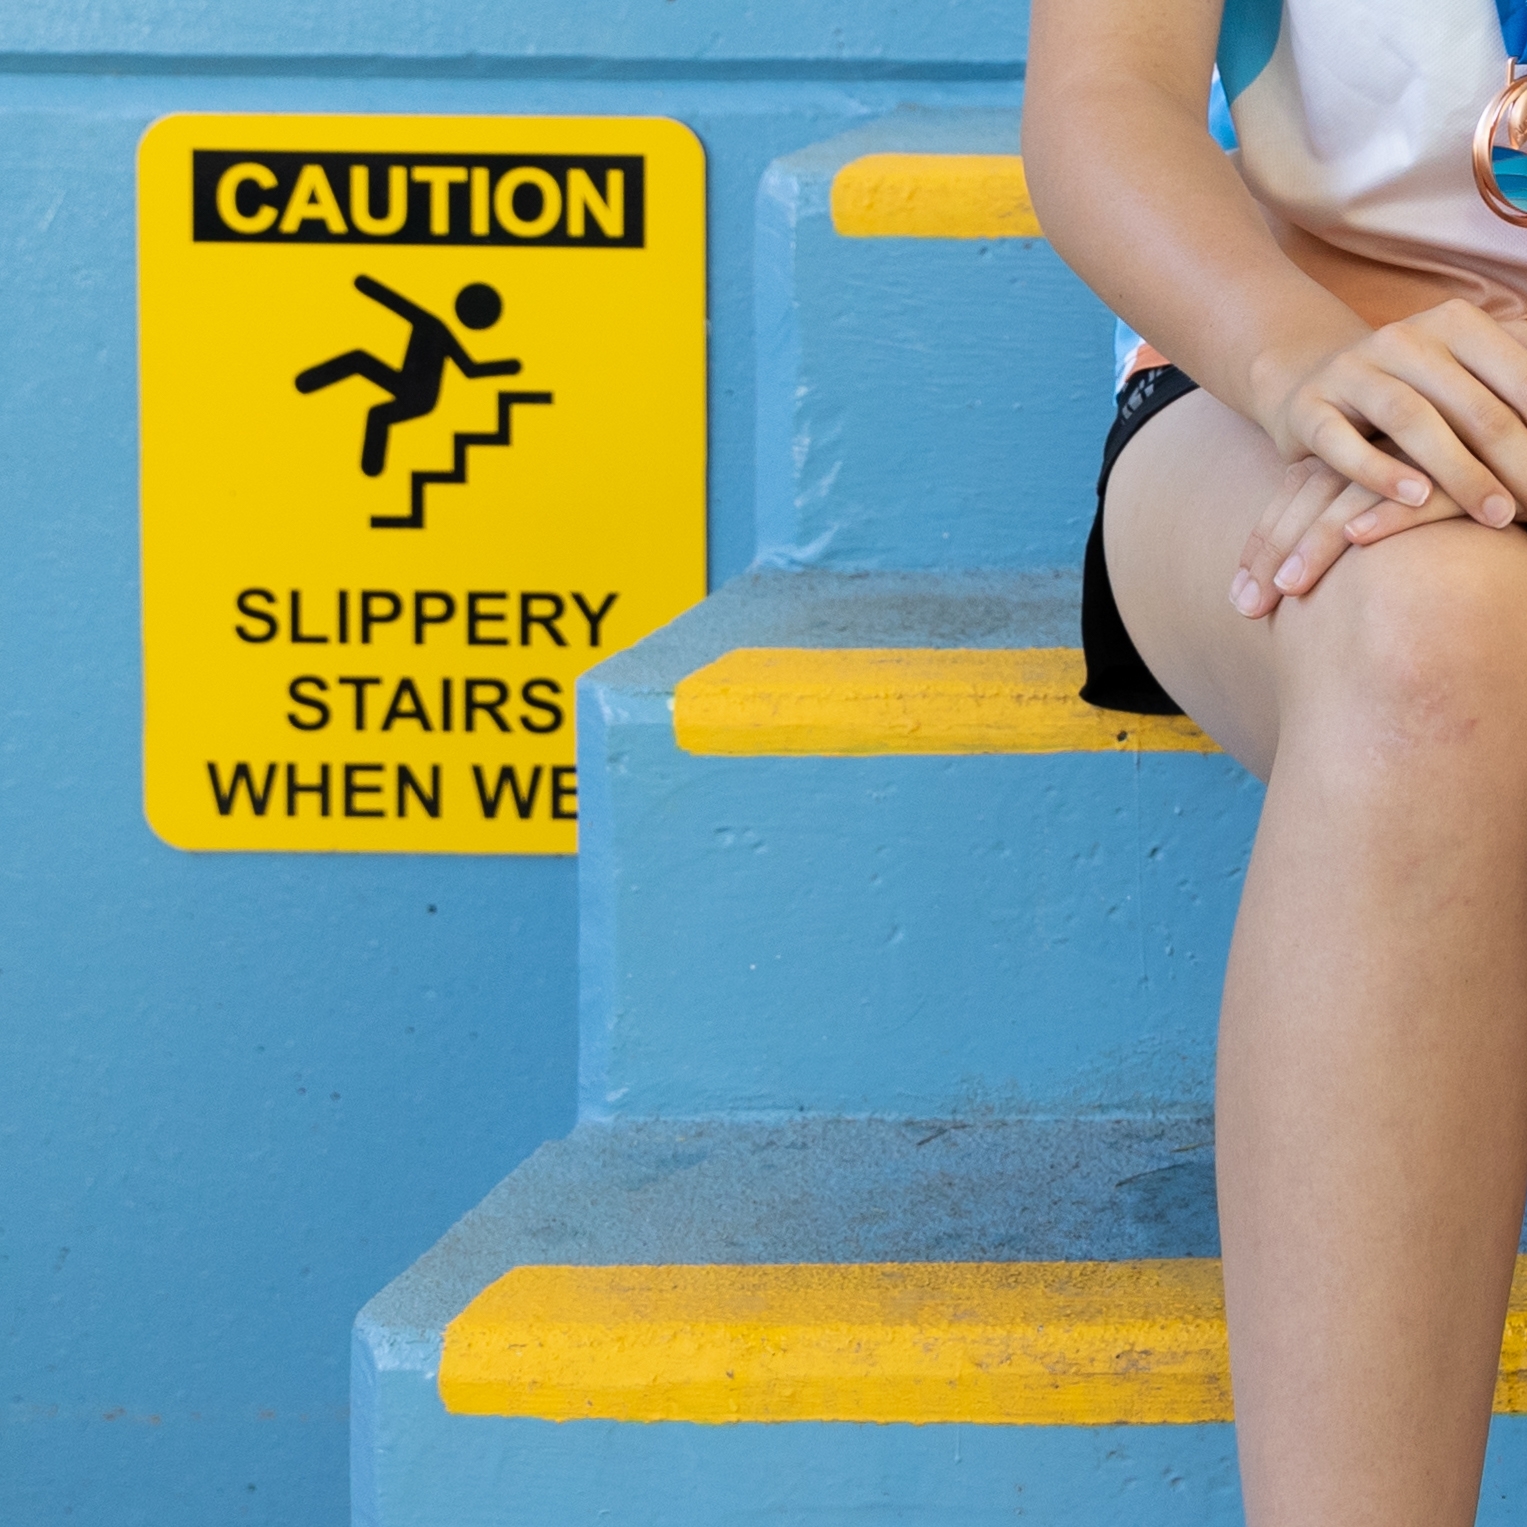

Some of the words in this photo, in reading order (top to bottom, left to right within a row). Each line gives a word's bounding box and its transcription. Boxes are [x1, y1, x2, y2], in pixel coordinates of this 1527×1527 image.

[215, 161, 626, 239] CAUTION
[234, 586, 620, 648] SLIPPERY
[286, 674, 565, 735] STAIRS
[206, 761, 443, 820] WHEN
